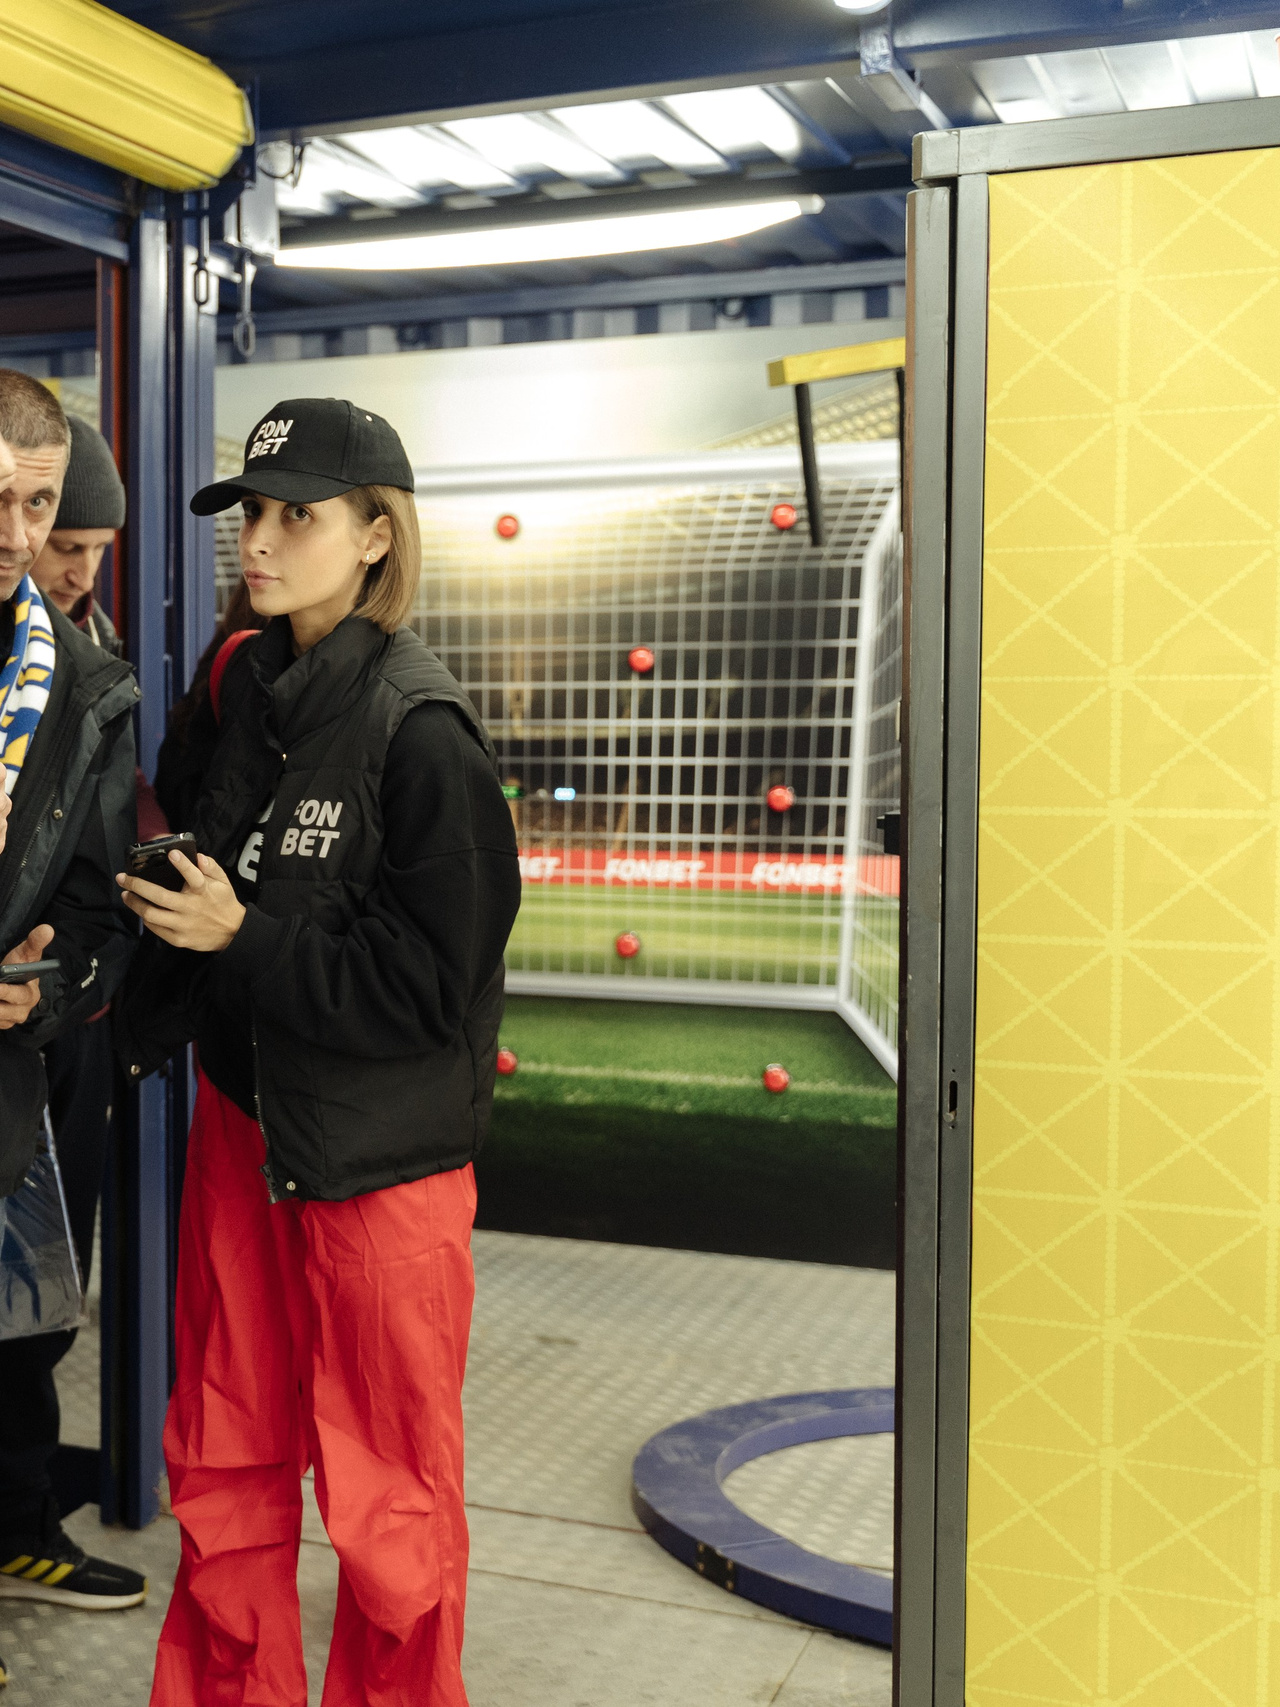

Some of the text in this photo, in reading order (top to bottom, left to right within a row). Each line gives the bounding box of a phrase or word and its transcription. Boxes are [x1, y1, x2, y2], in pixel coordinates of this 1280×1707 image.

[252, 419, 294, 442] FON
[247, 437, 288, 460] BET
[280, 828, 340, 858] BET
[604, 858, 706, 882] FONBET
